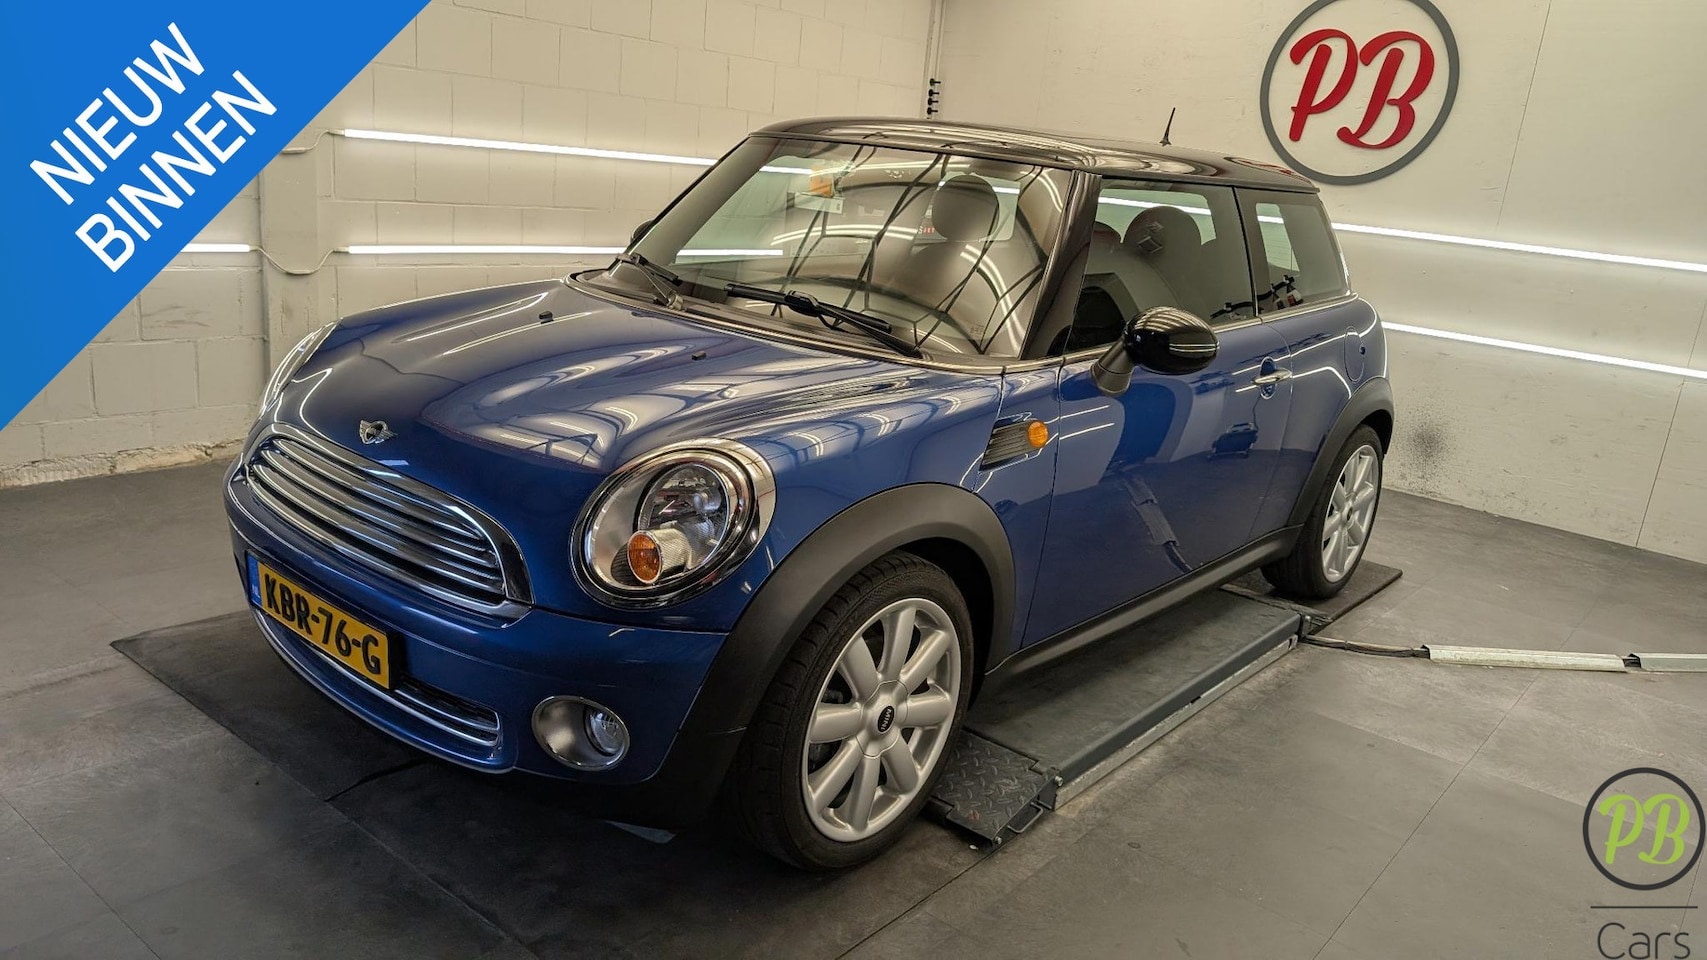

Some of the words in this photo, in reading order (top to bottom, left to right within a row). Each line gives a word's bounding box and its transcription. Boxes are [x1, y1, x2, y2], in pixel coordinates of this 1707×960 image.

[1289, 29, 1435, 150] PB
[264, 573, 381, 675] KBR-76-G
[880, 708, 892, 730] MINI
